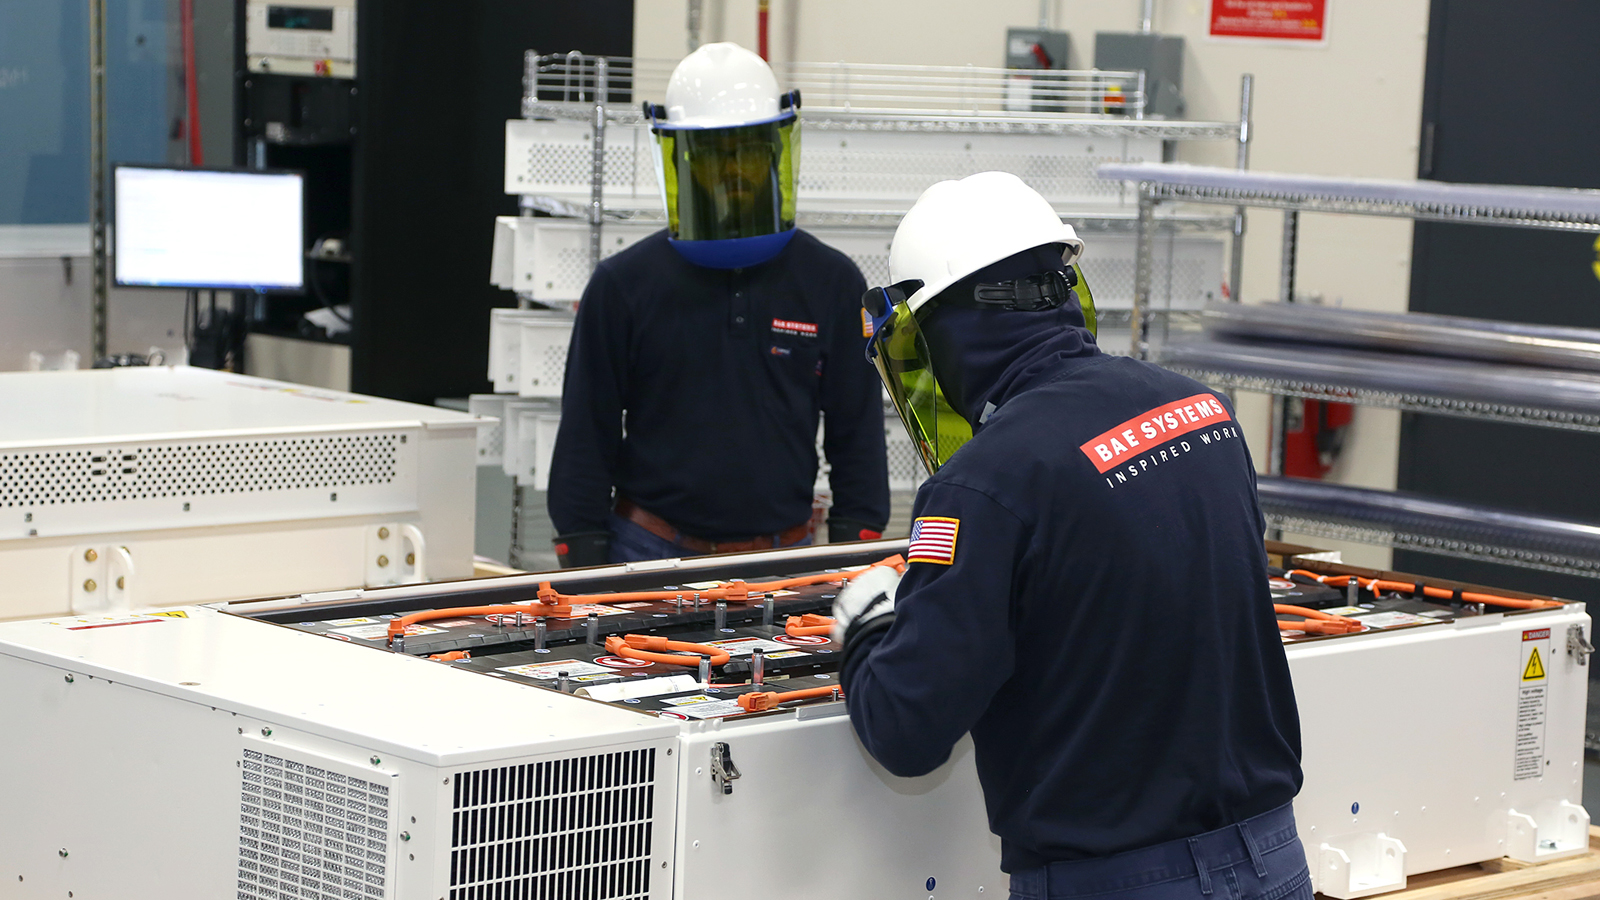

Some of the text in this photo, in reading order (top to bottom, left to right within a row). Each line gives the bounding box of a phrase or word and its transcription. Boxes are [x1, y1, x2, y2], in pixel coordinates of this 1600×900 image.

[1094, 398, 1223, 463] BAE SYSTEMS
[1106, 441, 1191, 489] INSPIRED
[1528, 630, 1550, 640] DANGER
